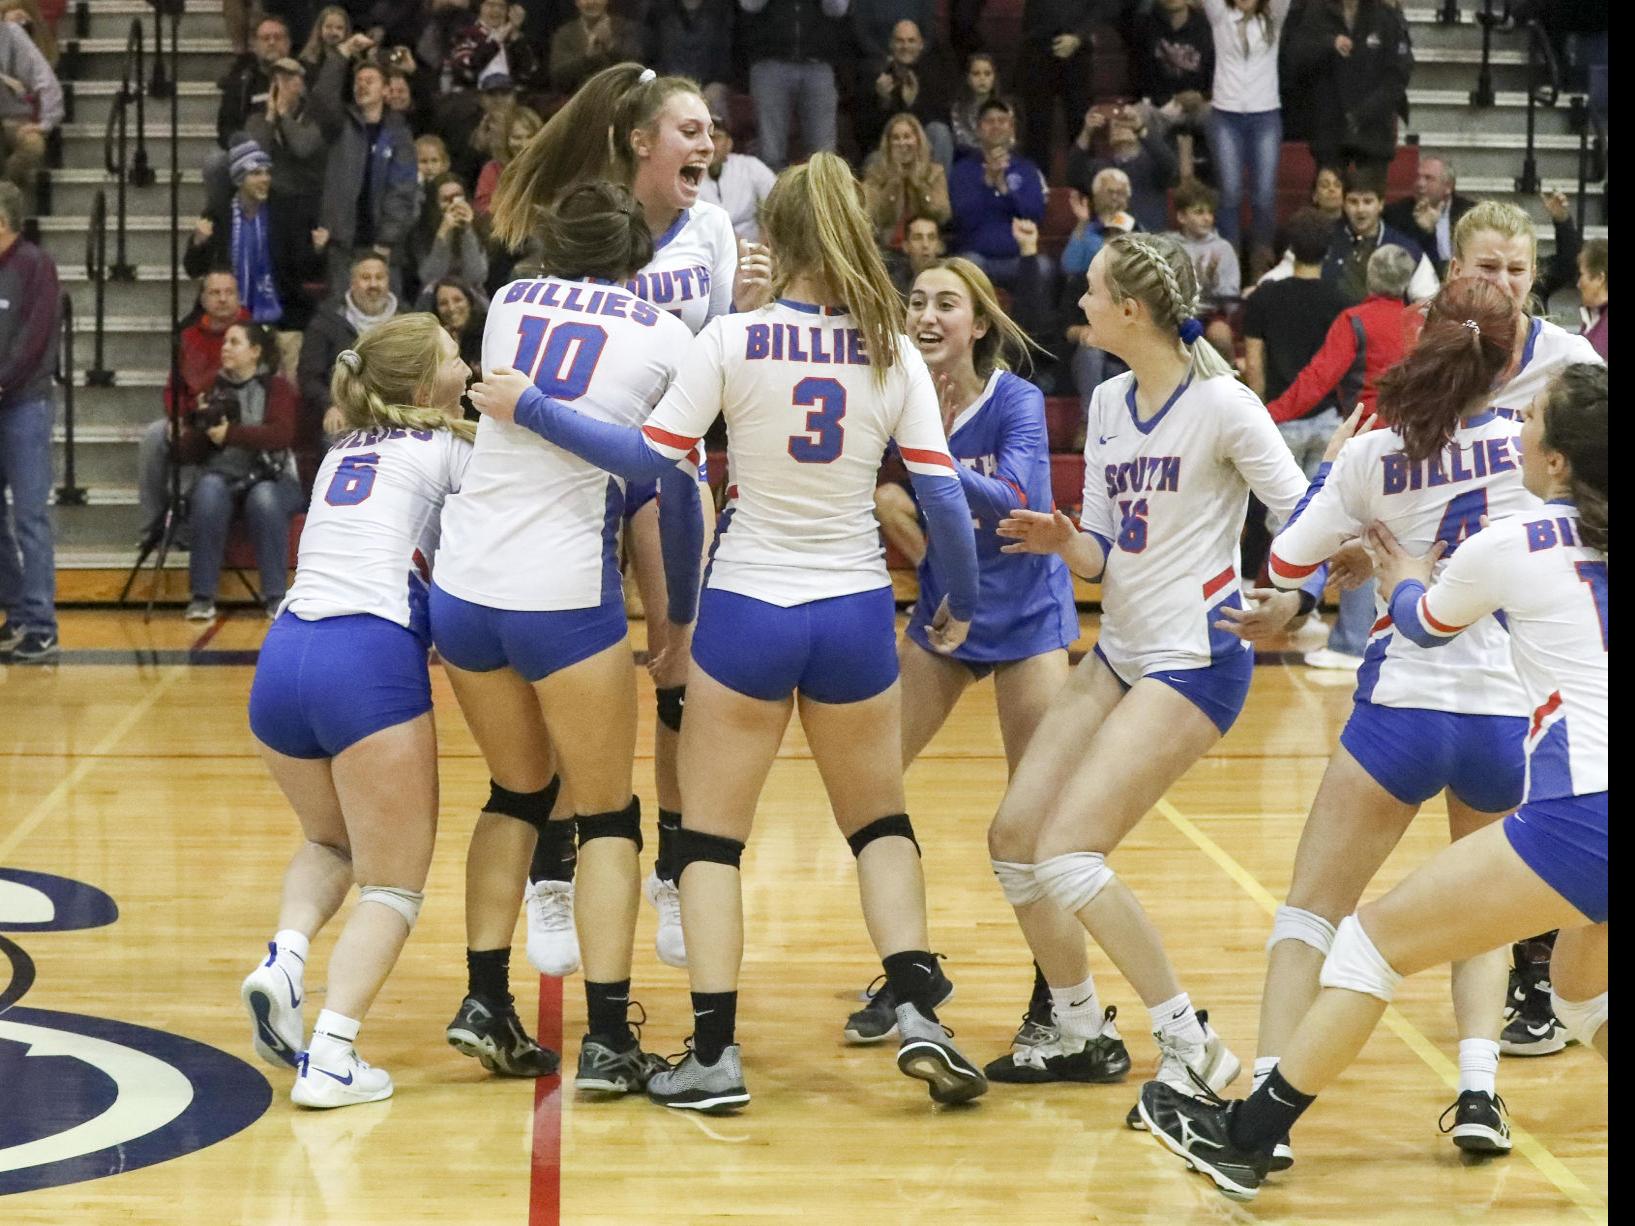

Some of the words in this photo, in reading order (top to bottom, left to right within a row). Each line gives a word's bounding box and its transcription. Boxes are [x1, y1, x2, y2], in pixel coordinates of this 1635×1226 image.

[503, 278, 660, 327] BILLIES
[625, 266, 710, 303] OUTH
[512, 315, 609, 401] 10
[745, 323, 893, 368] BILLIE
[787, 376, 848, 464] 3
[324, 451, 381, 507] 6
[1105, 456, 1181, 499] SOUTH
[1434, 487, 1488, 558] 4
